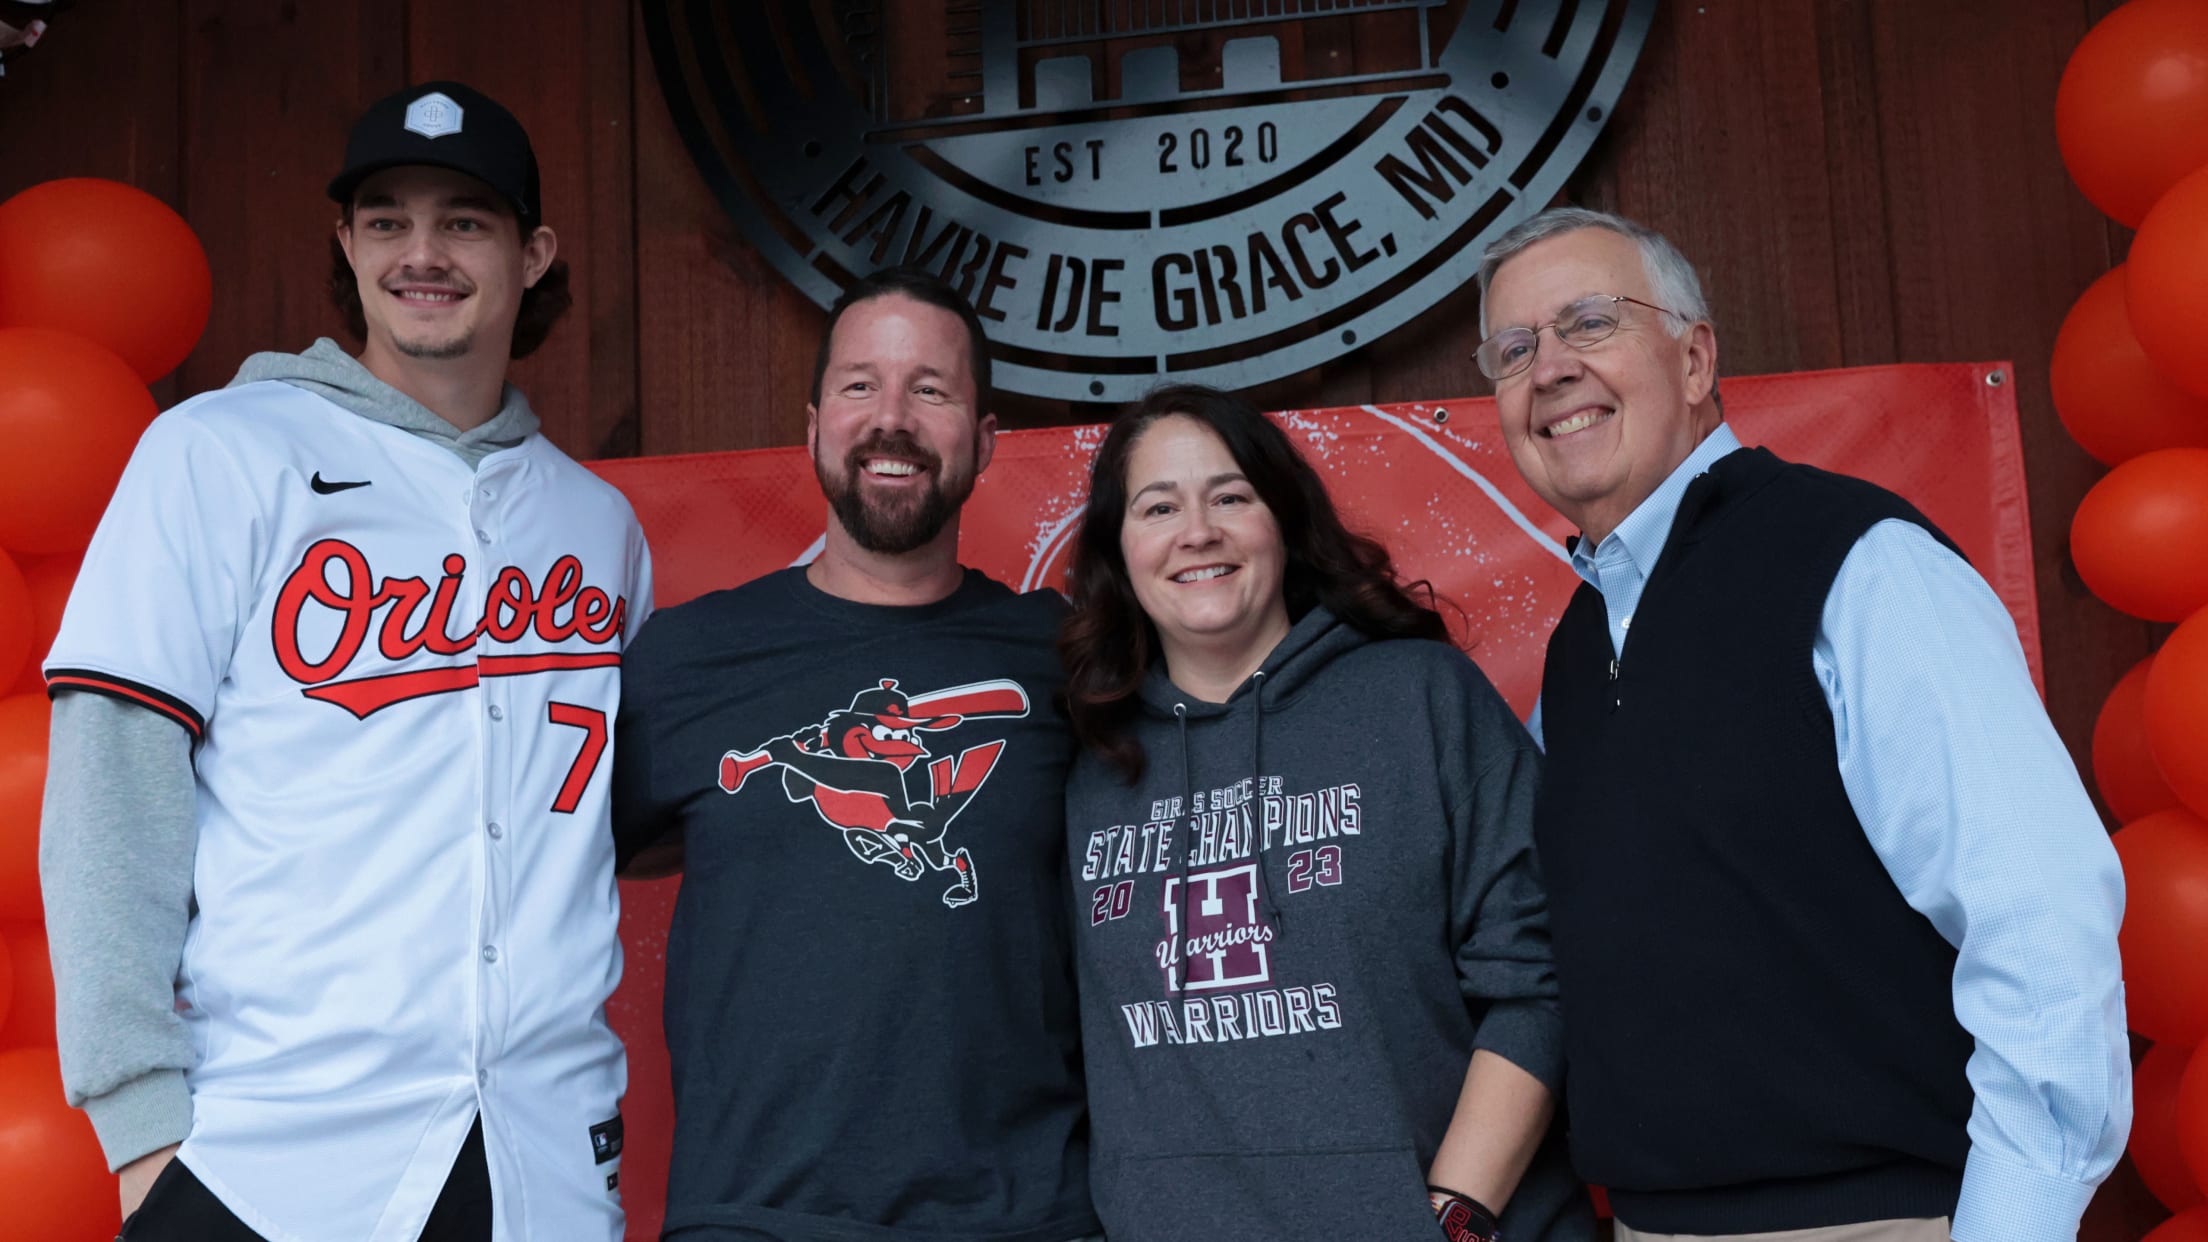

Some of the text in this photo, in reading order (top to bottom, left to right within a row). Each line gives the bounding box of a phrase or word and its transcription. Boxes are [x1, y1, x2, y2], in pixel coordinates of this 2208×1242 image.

[1025, 121, 1278, 186] EST 2020
[811, 95, 1504, 337] HAVRE DE GRACE, MD
[548, 701, 608, 814] 7
[1150, 775, 1284, 821] GIRS SOCCER
[1081, 819, 1176, 881] STATE
[1091, 845, 1342, 927] 20 23
[1121, 983, 1342, 1048] WARRIORS
